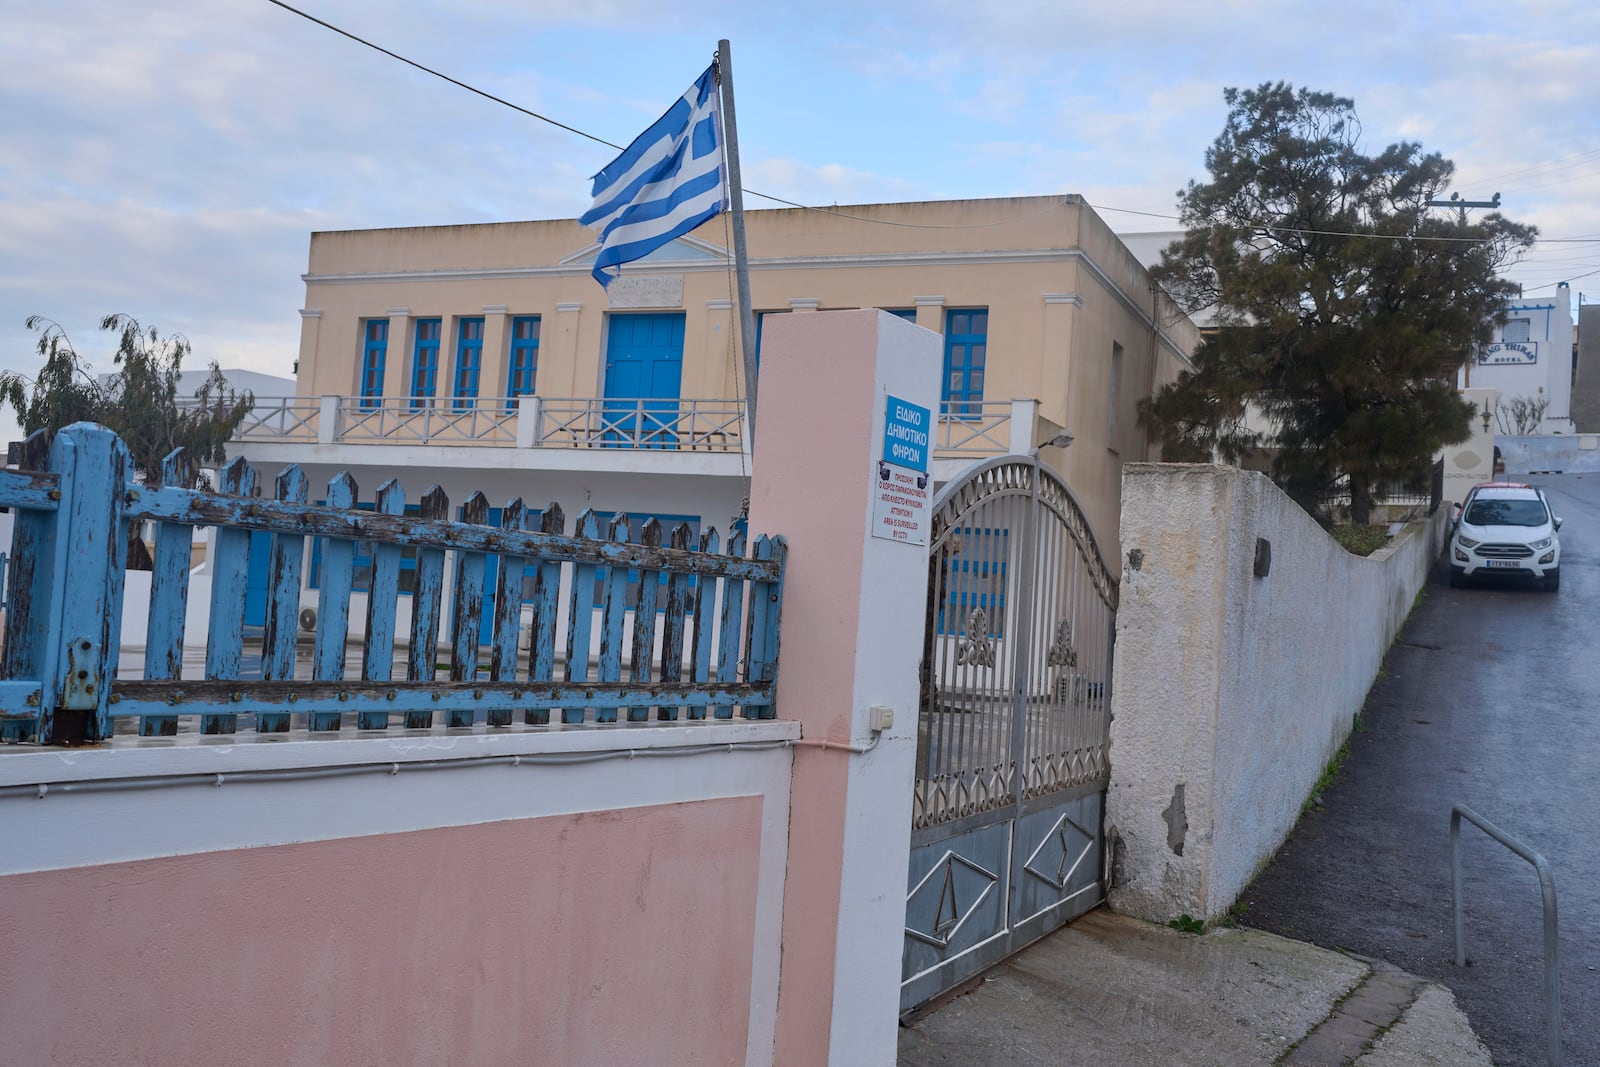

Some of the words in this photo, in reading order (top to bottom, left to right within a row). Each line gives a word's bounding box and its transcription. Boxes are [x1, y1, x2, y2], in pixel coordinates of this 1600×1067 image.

[895, 405, 921, 426] ΕΙΔΙΚΟ
[887, 422, 927, 446] ΔΗΜΟΤΙΚΟ
[892, 443, 920, 463] ΦΗΡΩΝ
[883, 517, 893, 526] AREA
